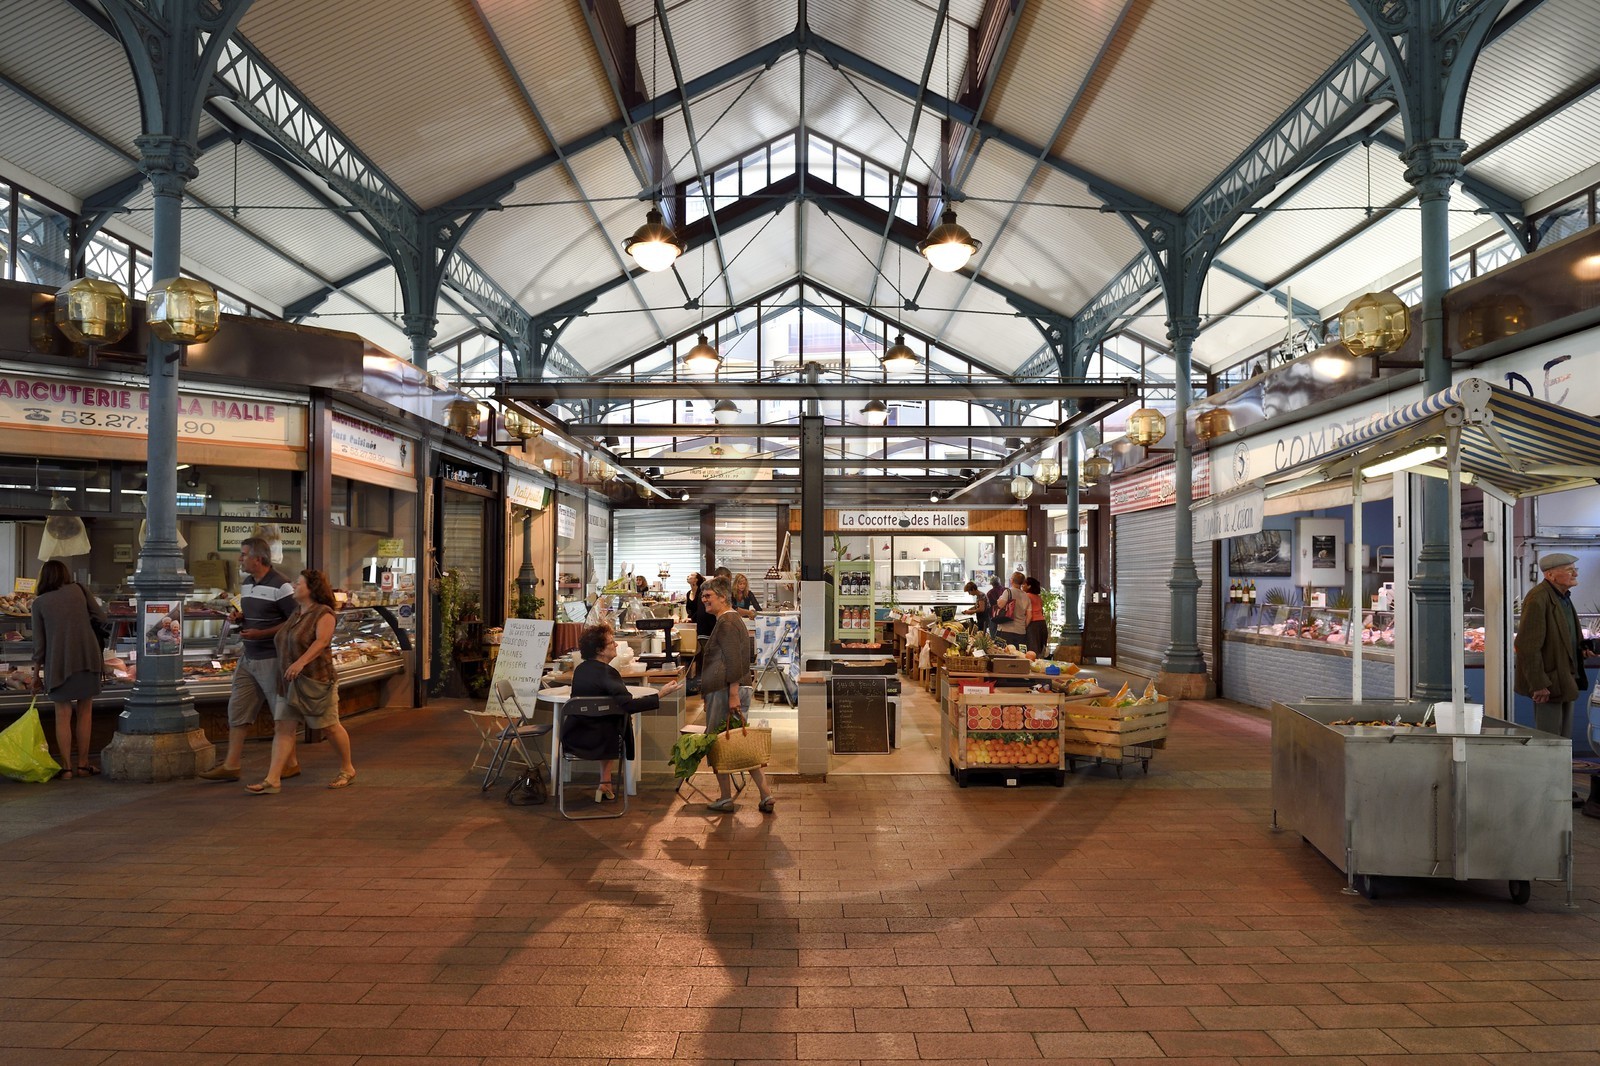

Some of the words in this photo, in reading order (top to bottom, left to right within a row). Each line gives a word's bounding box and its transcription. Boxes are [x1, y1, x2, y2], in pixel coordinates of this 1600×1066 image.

[211, 400, 275, 423] HALLE
[842, 513, 854, 526] La
[857, 513, 898, 526] Cocotte
[910, 513, 929, 526] des
[932, 513, 966, 526] Halles
[223, 525, 254, 534] FABRICA
